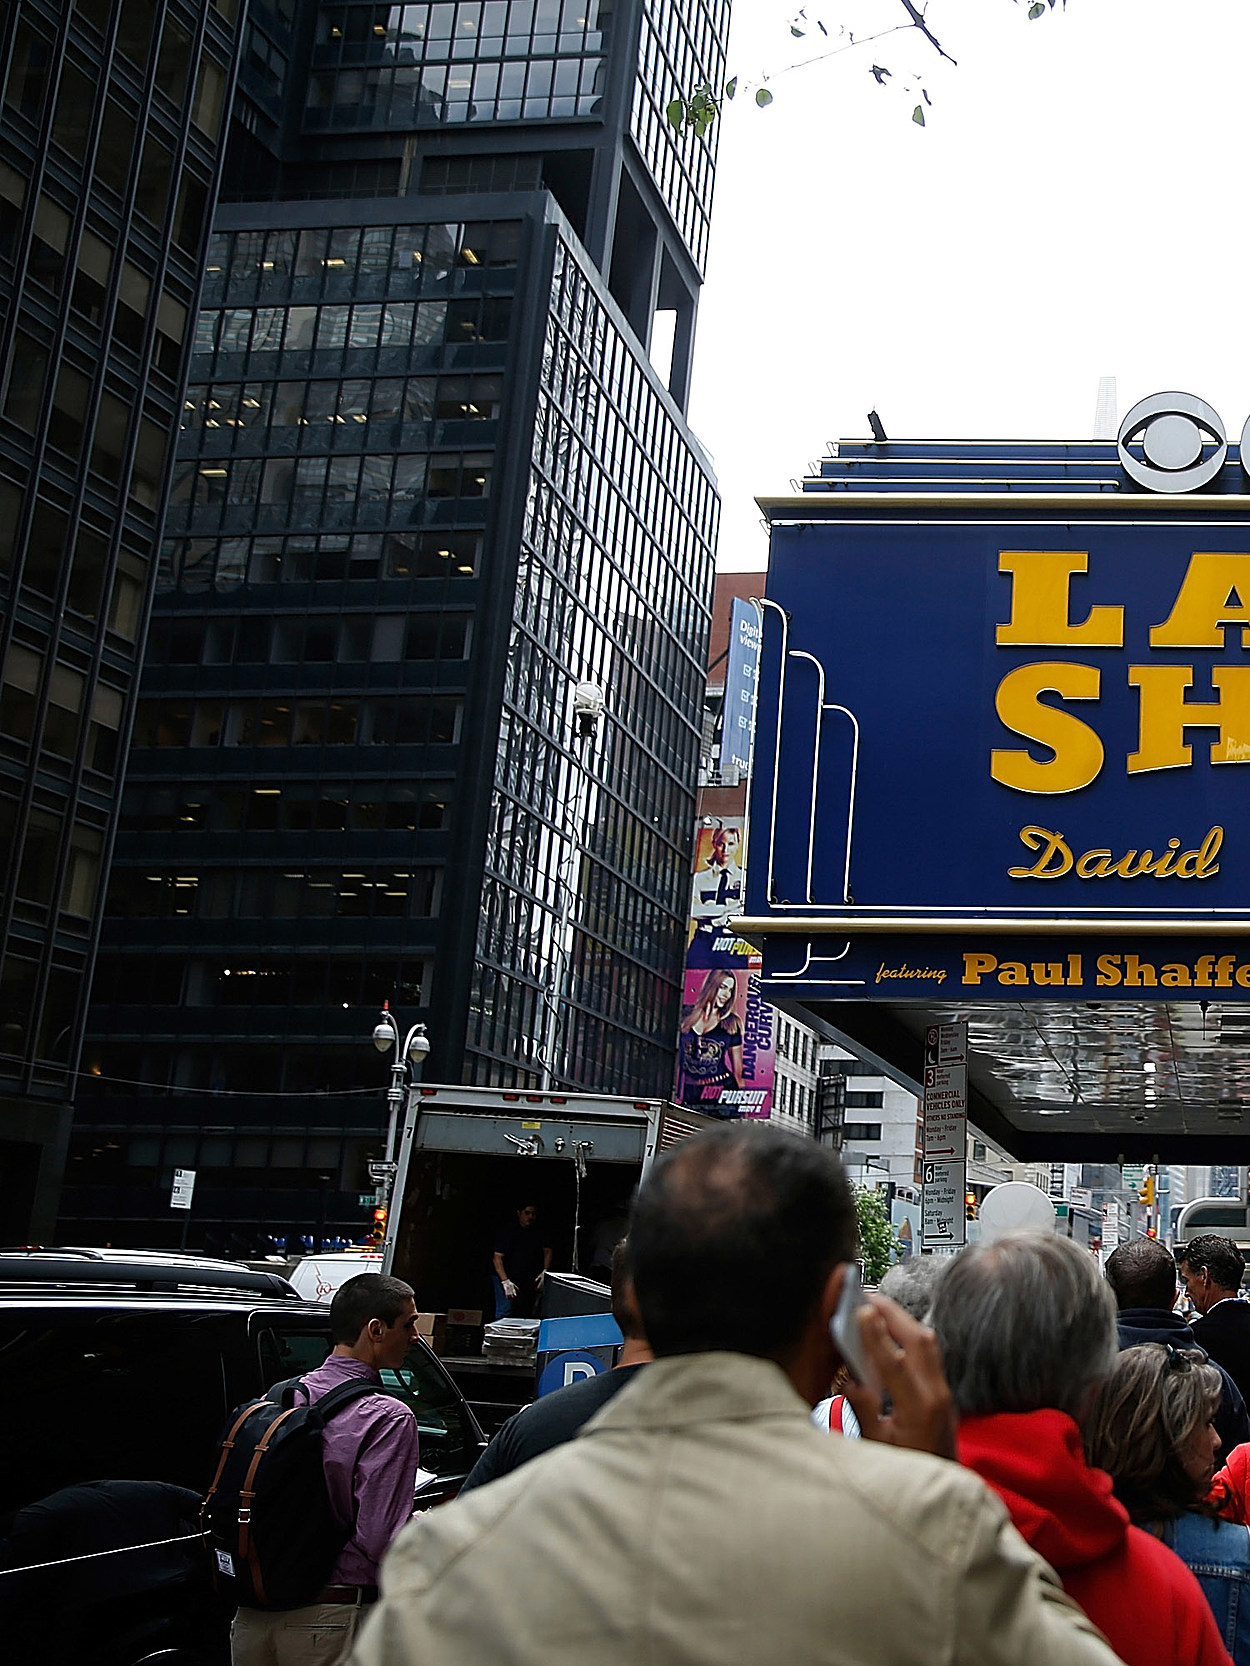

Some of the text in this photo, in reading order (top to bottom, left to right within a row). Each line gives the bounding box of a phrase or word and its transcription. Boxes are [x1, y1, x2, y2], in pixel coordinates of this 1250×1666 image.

[1007, 825, 1224, 879] David
[712, 937, 736, 951] HOT
[875, 961, 948, 984] featuring
[961, 953, 1083, 986] Paul
[927, 1070, 935, 1086] 3
[717, 1090, 768, 1105] PURSUIT
[927, 1090, 960, 1101] COMMERCIAL
[926, 1102, 950, 1111] VEHICLES
[406, 1127, 413, 1138] 7
[646, 1145, 653, 1156] 7
[926, 1165, 933, 1183] 6
